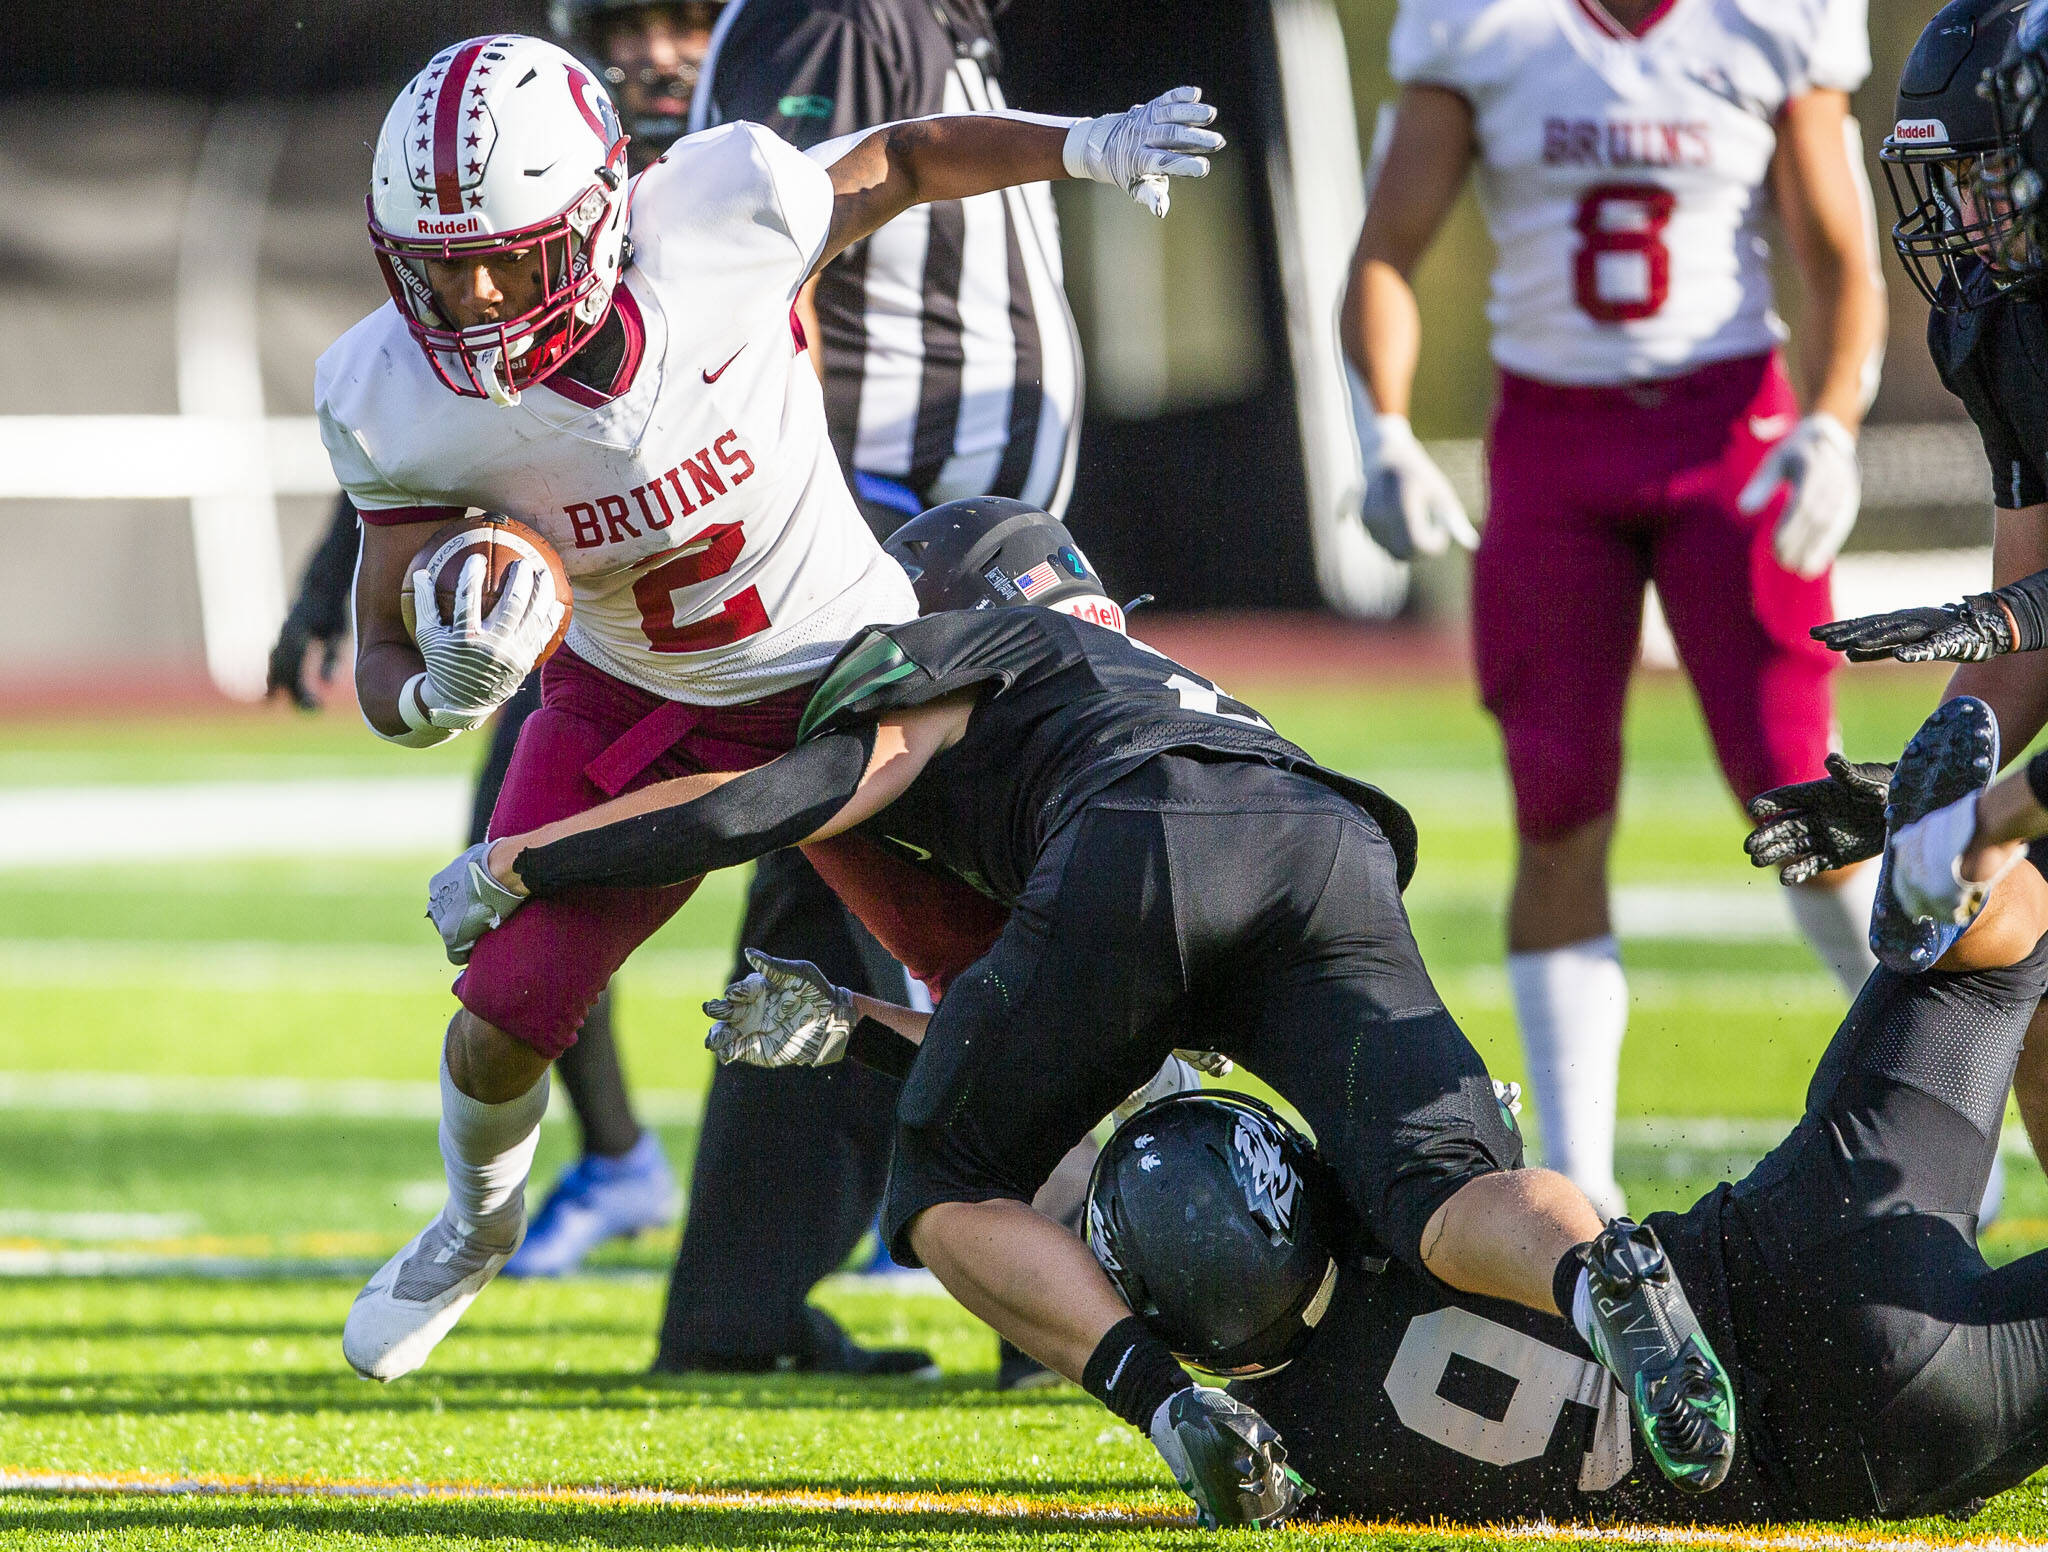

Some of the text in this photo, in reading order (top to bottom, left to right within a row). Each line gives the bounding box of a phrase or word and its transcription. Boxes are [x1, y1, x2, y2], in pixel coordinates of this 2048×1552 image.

[1543, 118, 1714, 168] BRUINS
[1896, 124, 1935, 139] Riddell
[417, 217, 479, 235] Riddell
[1573, 183, 1676, 323] 8
[562, 428, 755, 549] BRUINS
[631, 519, 773, 654] 2
